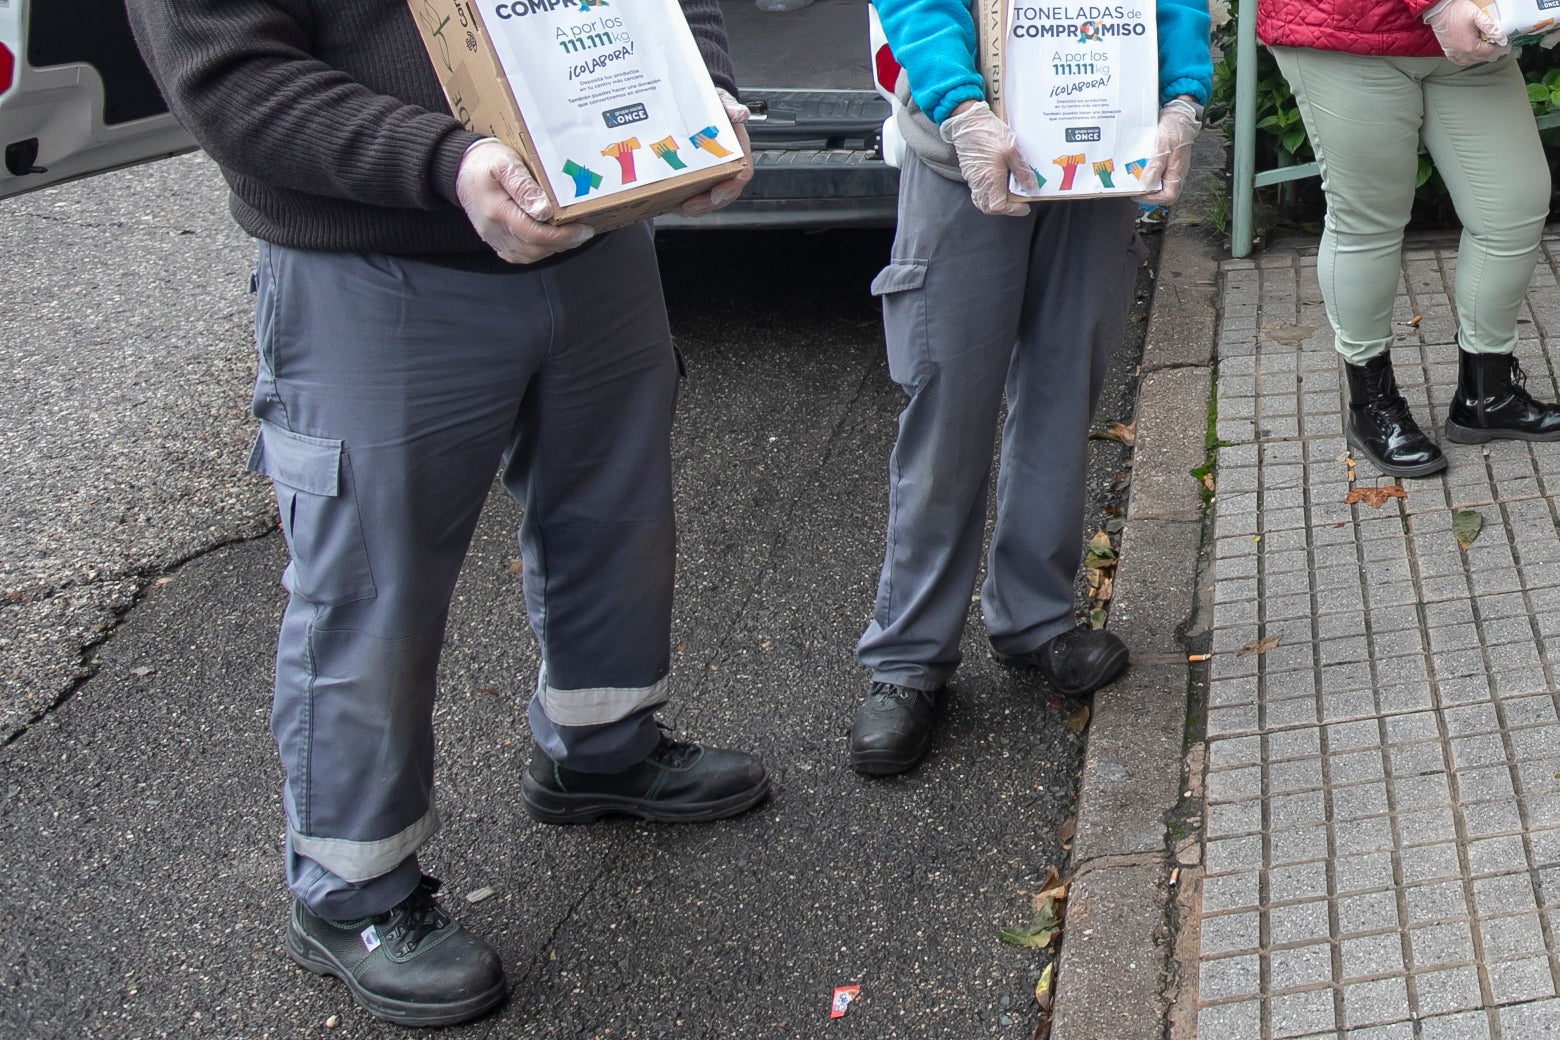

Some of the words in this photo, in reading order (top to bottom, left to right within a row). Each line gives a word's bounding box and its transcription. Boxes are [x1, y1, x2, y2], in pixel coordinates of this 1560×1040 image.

[1014, 6, 1125, 21] TONELADAS
[1126, 9, 1142, 20] de
[556, 26, 569, 40] A
[570, 21, 597, 38] por
[599, 17, 623, 30] los
[1013, 22, 1146, 39] COMPROMISO
[1052, 51, 1062, 62] A
[1065, 51, 1087, 64] por
[1090, 50, 1108, 61] los
[992, 37, 1000, 107] VERDE
[617, 110, 646, 124] ONCE
[1075, 132, 1099, 141] ONCE
